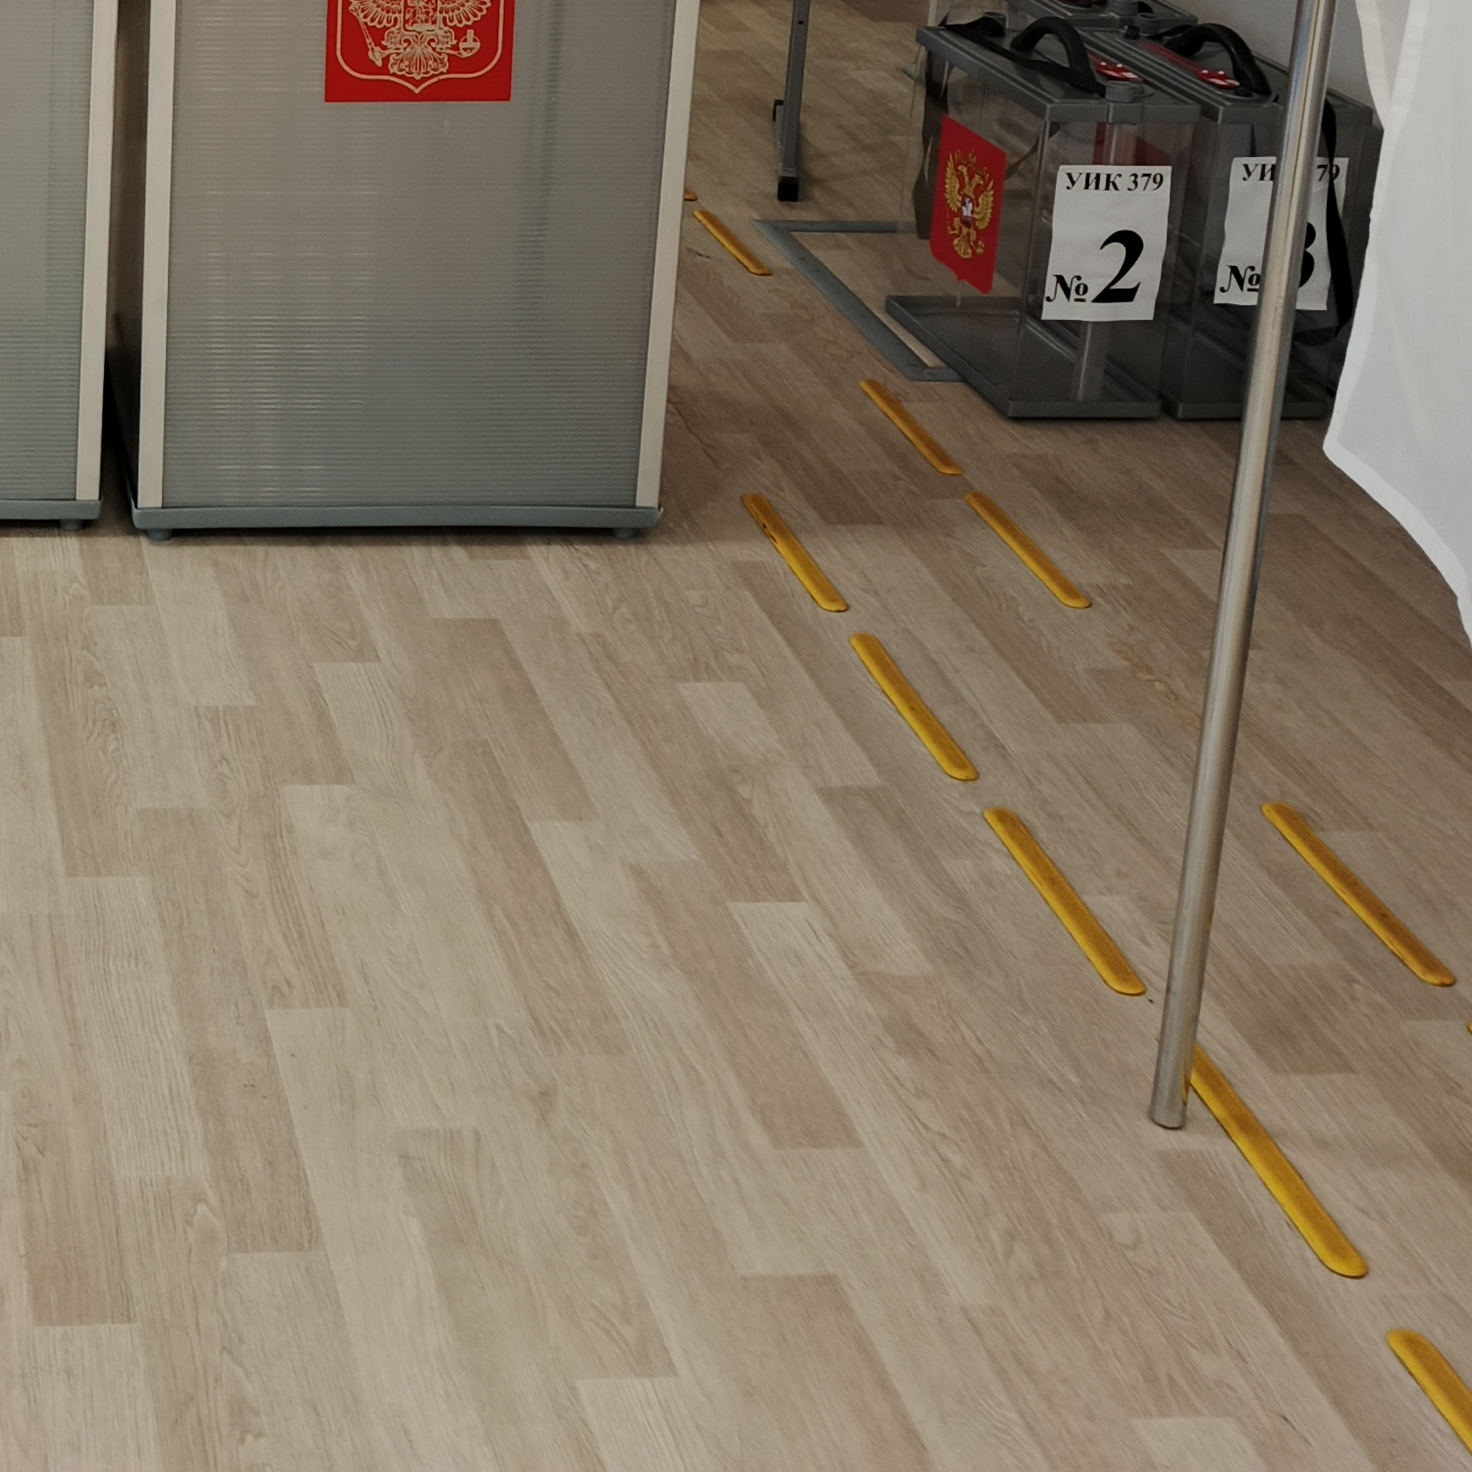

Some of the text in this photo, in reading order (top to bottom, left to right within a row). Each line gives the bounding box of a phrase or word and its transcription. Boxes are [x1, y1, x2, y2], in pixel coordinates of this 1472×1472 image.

[1065, 172, 1164, 191] УИК 379
[1242, 163, 1341, 182] УИ 79
[1091, 229, 1144, 304] 2
